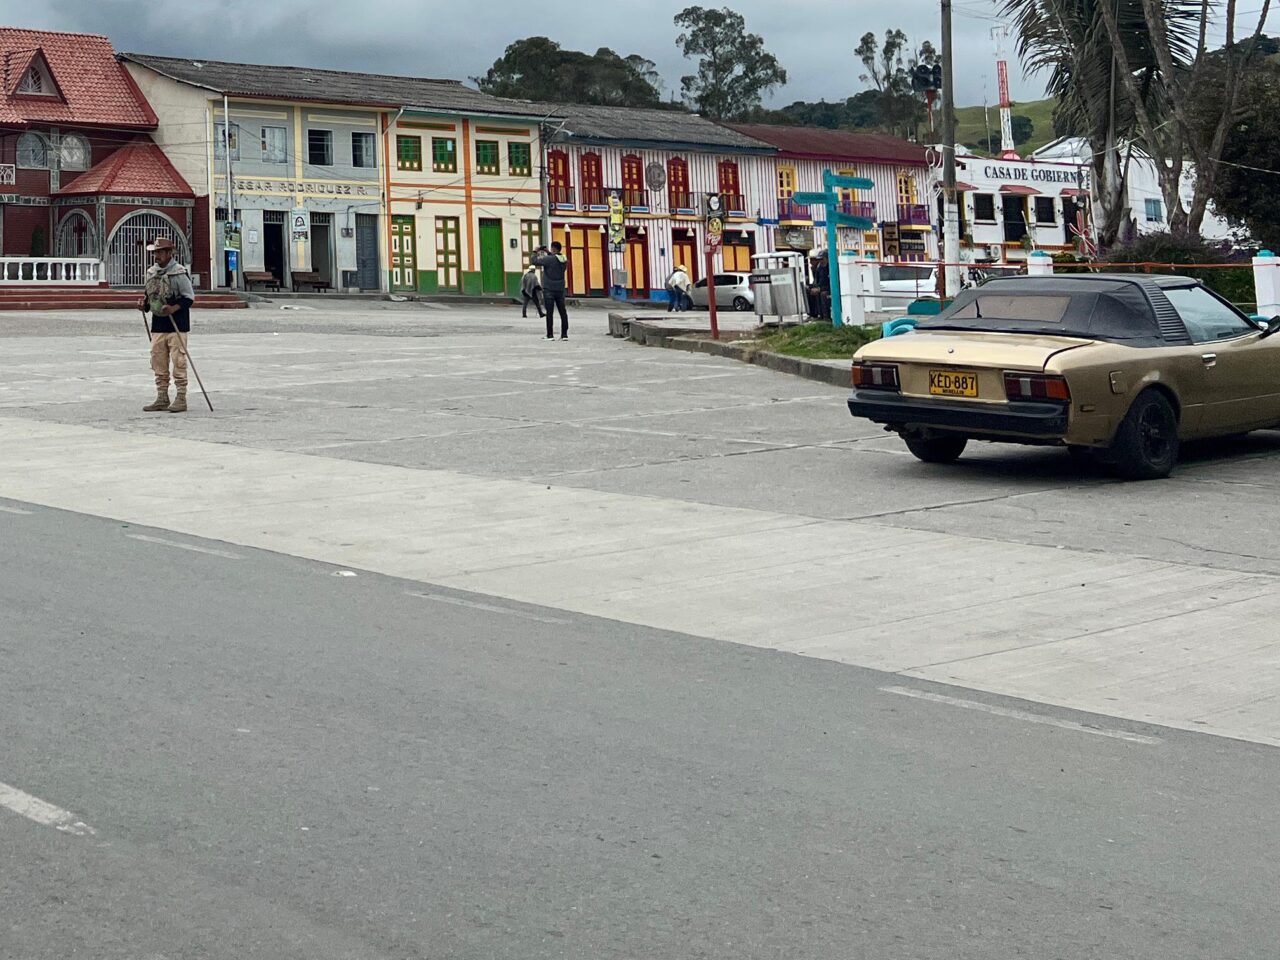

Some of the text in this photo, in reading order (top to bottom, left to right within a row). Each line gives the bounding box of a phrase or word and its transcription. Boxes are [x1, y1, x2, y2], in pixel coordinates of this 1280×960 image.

[984, 165, 1080, 183] CASA DE GOBIERN
[279, 182, 351, 195] RODRIGUEZ
